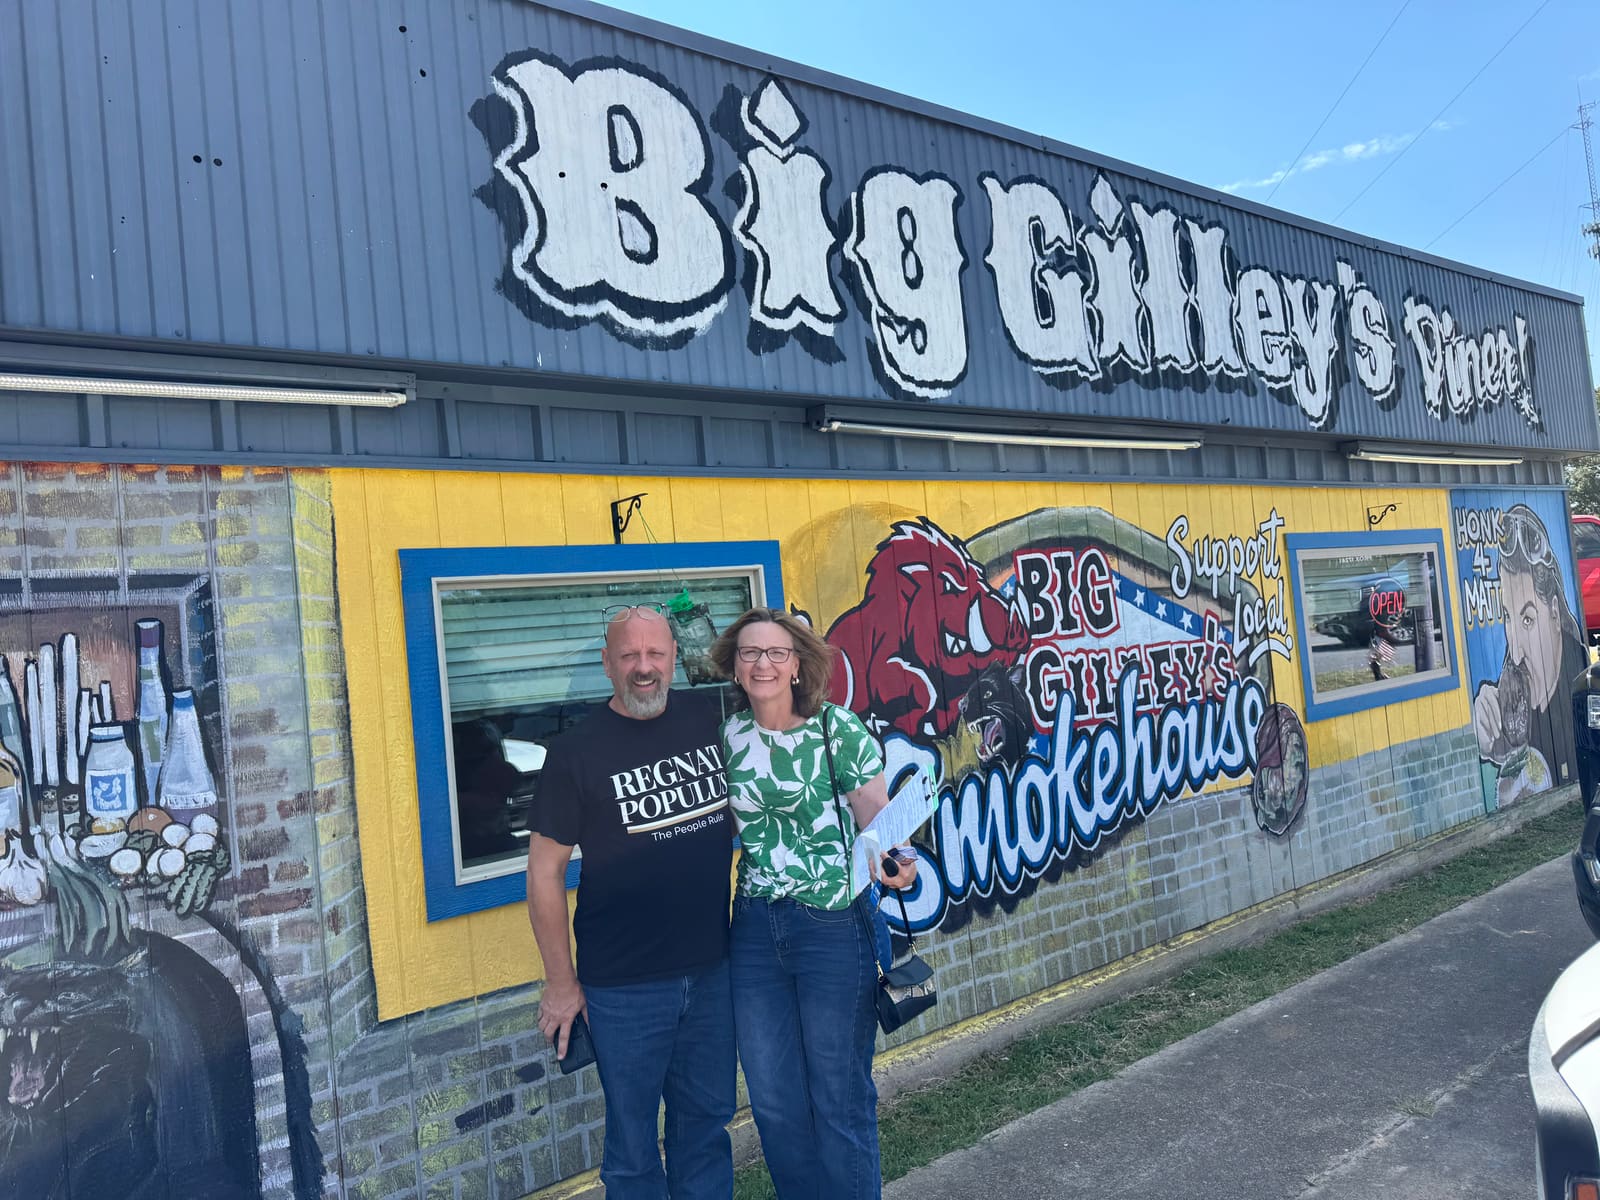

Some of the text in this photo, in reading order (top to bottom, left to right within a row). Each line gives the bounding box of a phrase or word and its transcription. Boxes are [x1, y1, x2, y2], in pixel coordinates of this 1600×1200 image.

[490, 50, 1540, 429] Big Gilley's Diner!
[1166, 507, 1285, 600] Support
[1455, 507, 1505, 548] HONK
[1473, 540, 1491, 578] 4
[1015, 548, 1120, 638] BIG
[1232, 576, 1288, 662] Local
[1371, 591, 1403, 616] OPEN
[1464, 575, 1503, 625] MATT
[1024, 608, 1235, 732] GILLEY'S
[610, 744, 724, 800] REGNAT
[618, 771, 728, 824] POPULUS
[651, 813, 725, 841] The People Rule
[882, 676, 1268, 928] Smokehouse
